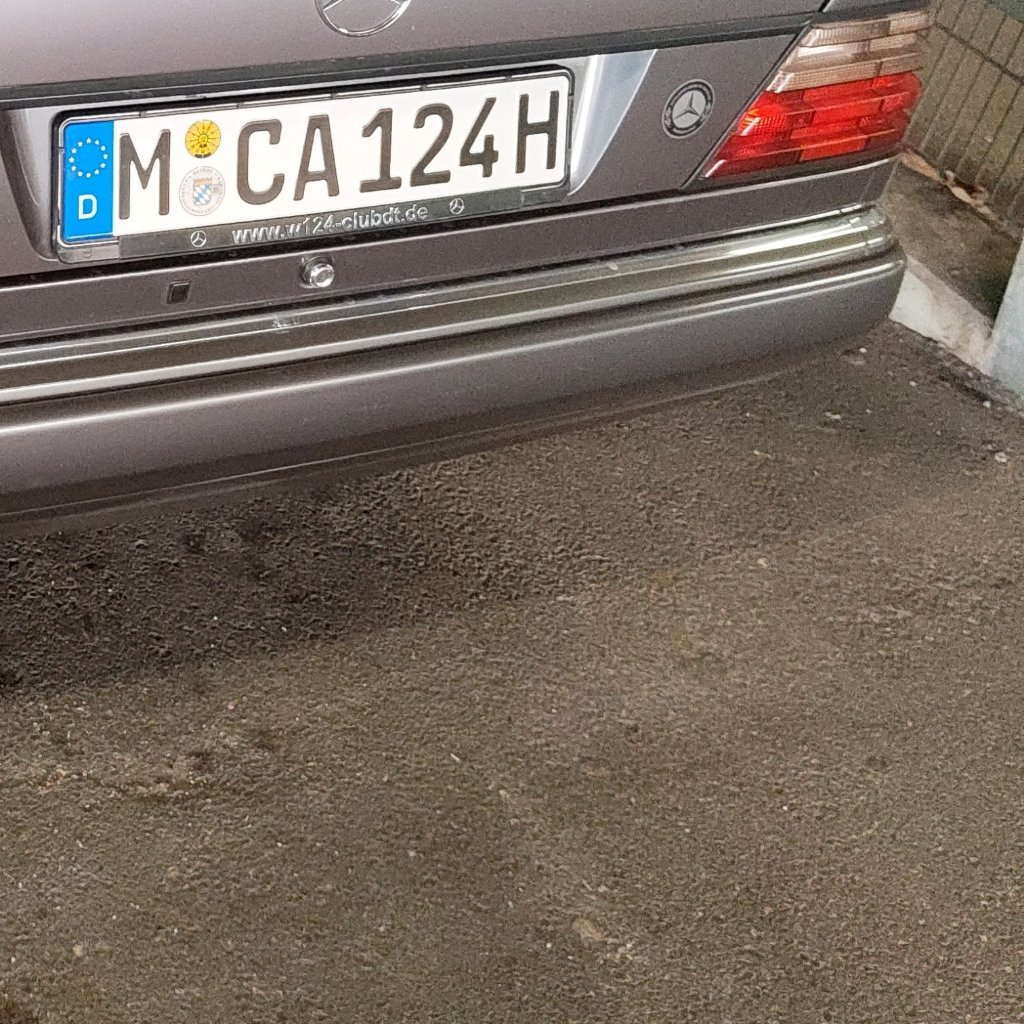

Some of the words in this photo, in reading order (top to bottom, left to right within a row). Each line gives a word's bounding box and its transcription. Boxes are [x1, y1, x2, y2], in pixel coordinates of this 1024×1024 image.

[119, 129, 171, 219] M
[78, 194, 98, 220] D
[232, 204, 429, 244] www.w124-clubdt.de
